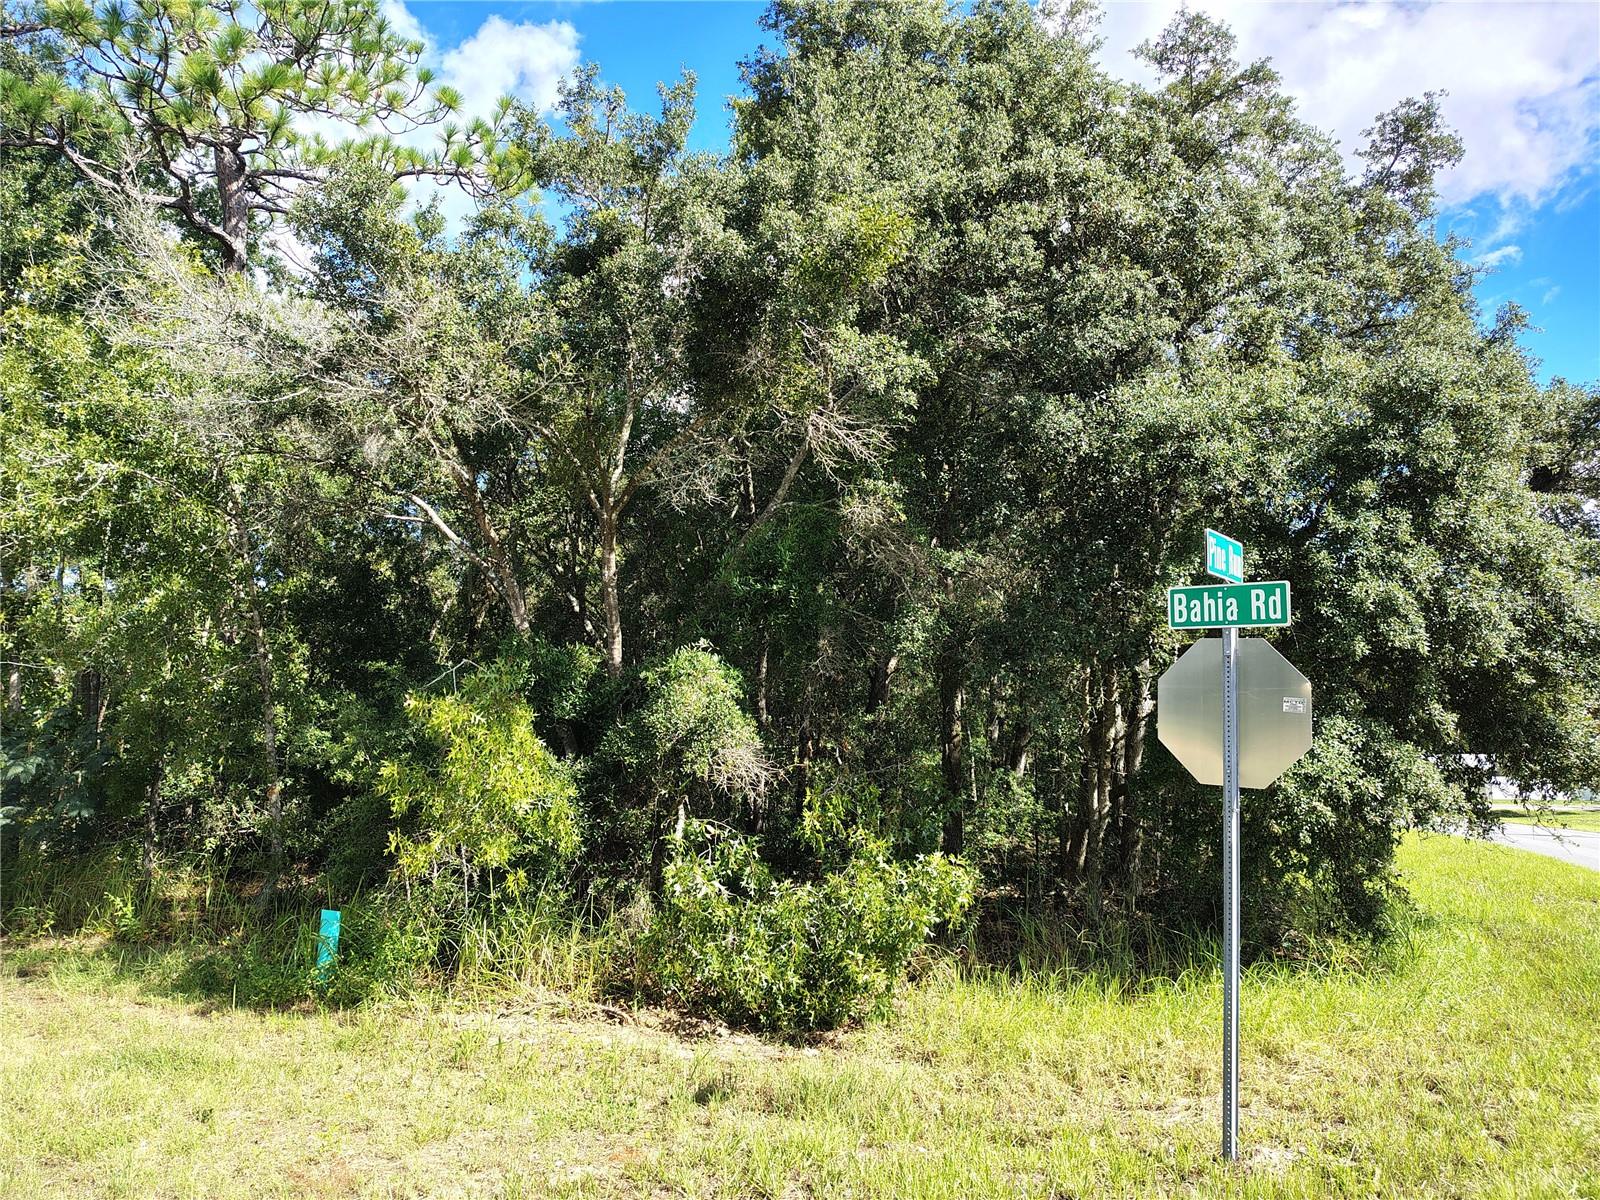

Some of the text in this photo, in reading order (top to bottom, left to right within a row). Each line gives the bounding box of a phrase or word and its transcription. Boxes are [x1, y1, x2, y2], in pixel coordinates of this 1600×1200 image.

[1209, 536, 1226, 572] Pine
[1173, 588, 1282, 622] Bahia Rd
